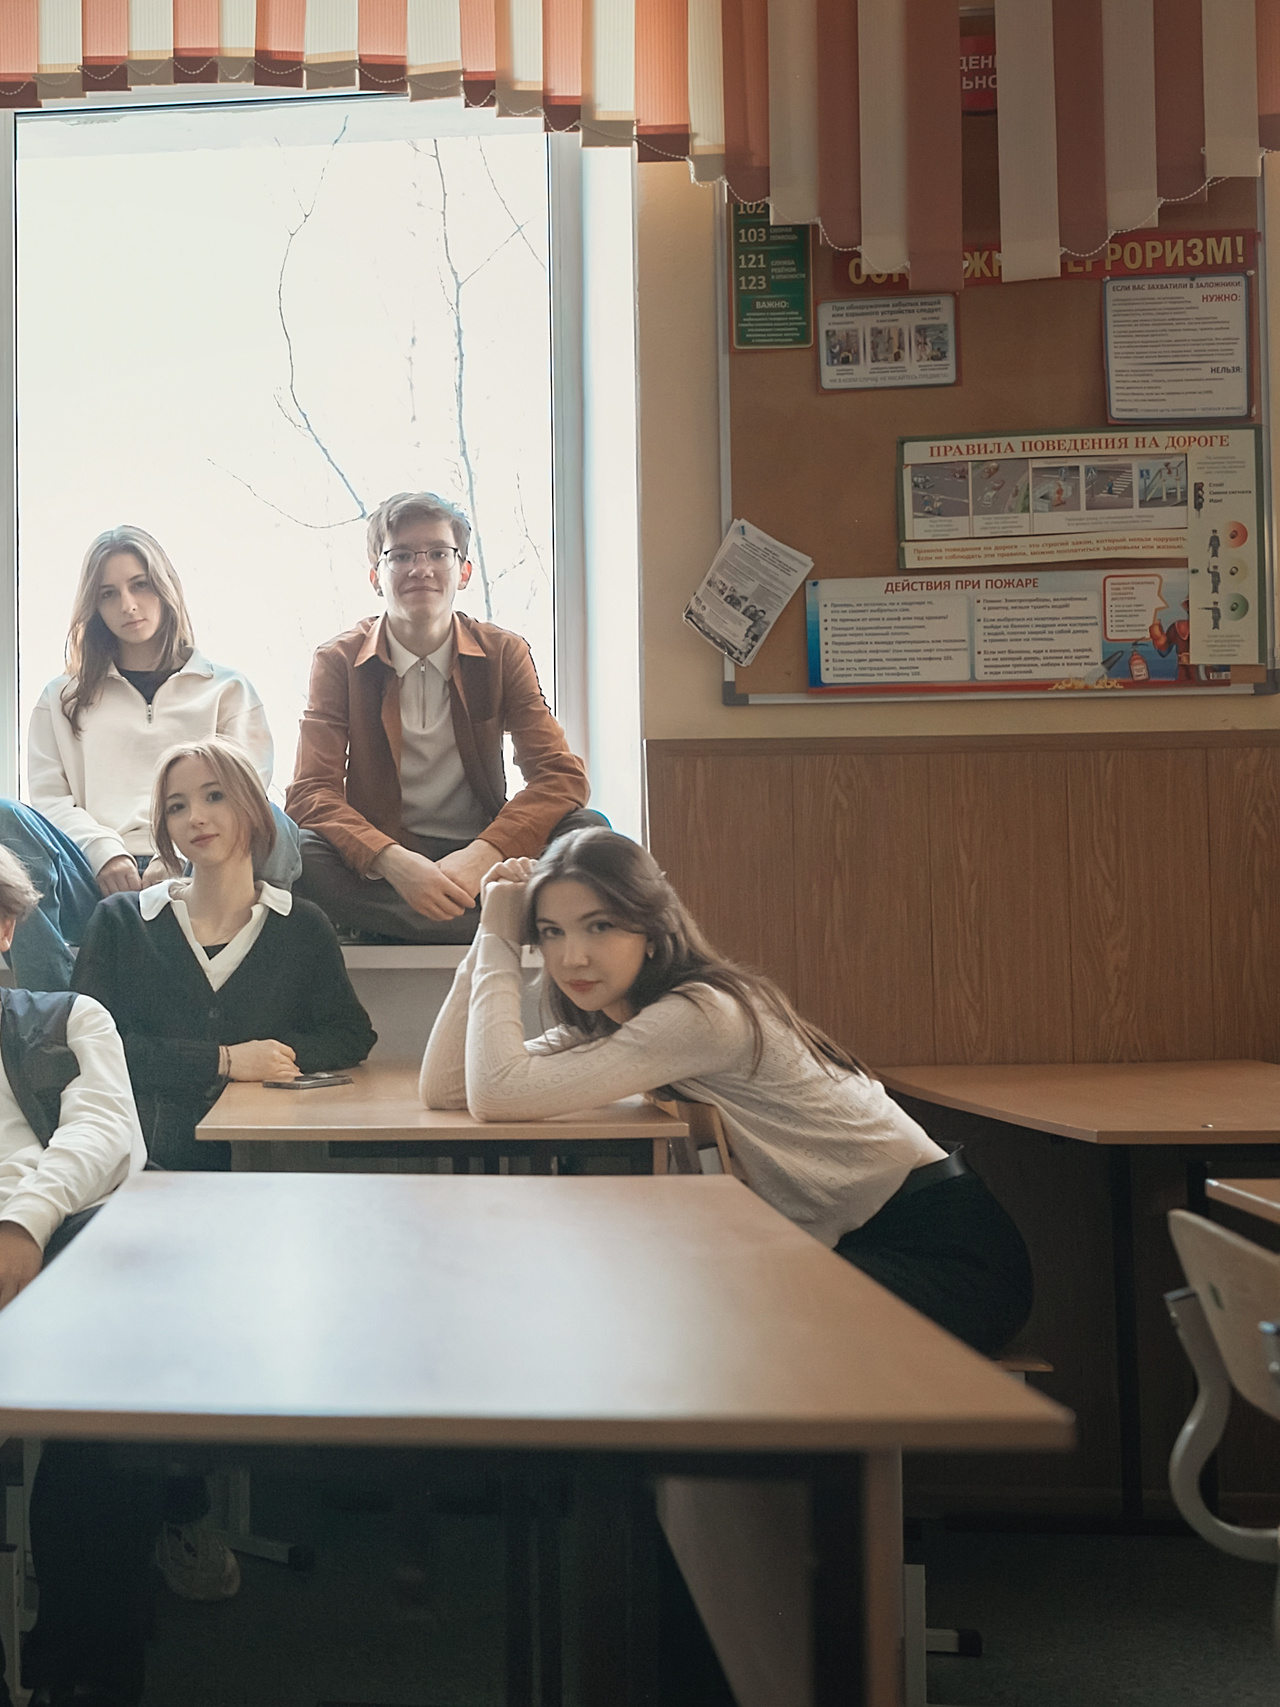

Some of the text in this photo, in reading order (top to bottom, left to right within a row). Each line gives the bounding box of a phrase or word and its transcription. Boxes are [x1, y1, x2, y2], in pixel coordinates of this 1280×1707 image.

[738, 203, 766, 214] 102
[738, 228, 766, 242] 103
[738, 254, 766, 268] 121
[739, 276, 767, 290] 123
[1112, 284, 1130, 292] ЕСЛИ
[1147, 282, 1188, 290] ЗАХВАТИЛИ
[756, 300, 790, 309] ВАЖНО:
[1202, 293, 1241, 302] НУЖНО:
[929, 435, 1230, 457] ПРАВИЛА ПОВЕДЕНИЯ НА ДОРОГЕ
[884, 578, 1039, 594] ДЕЙСТВИЯ ПРИ ПОЖАРЕ
